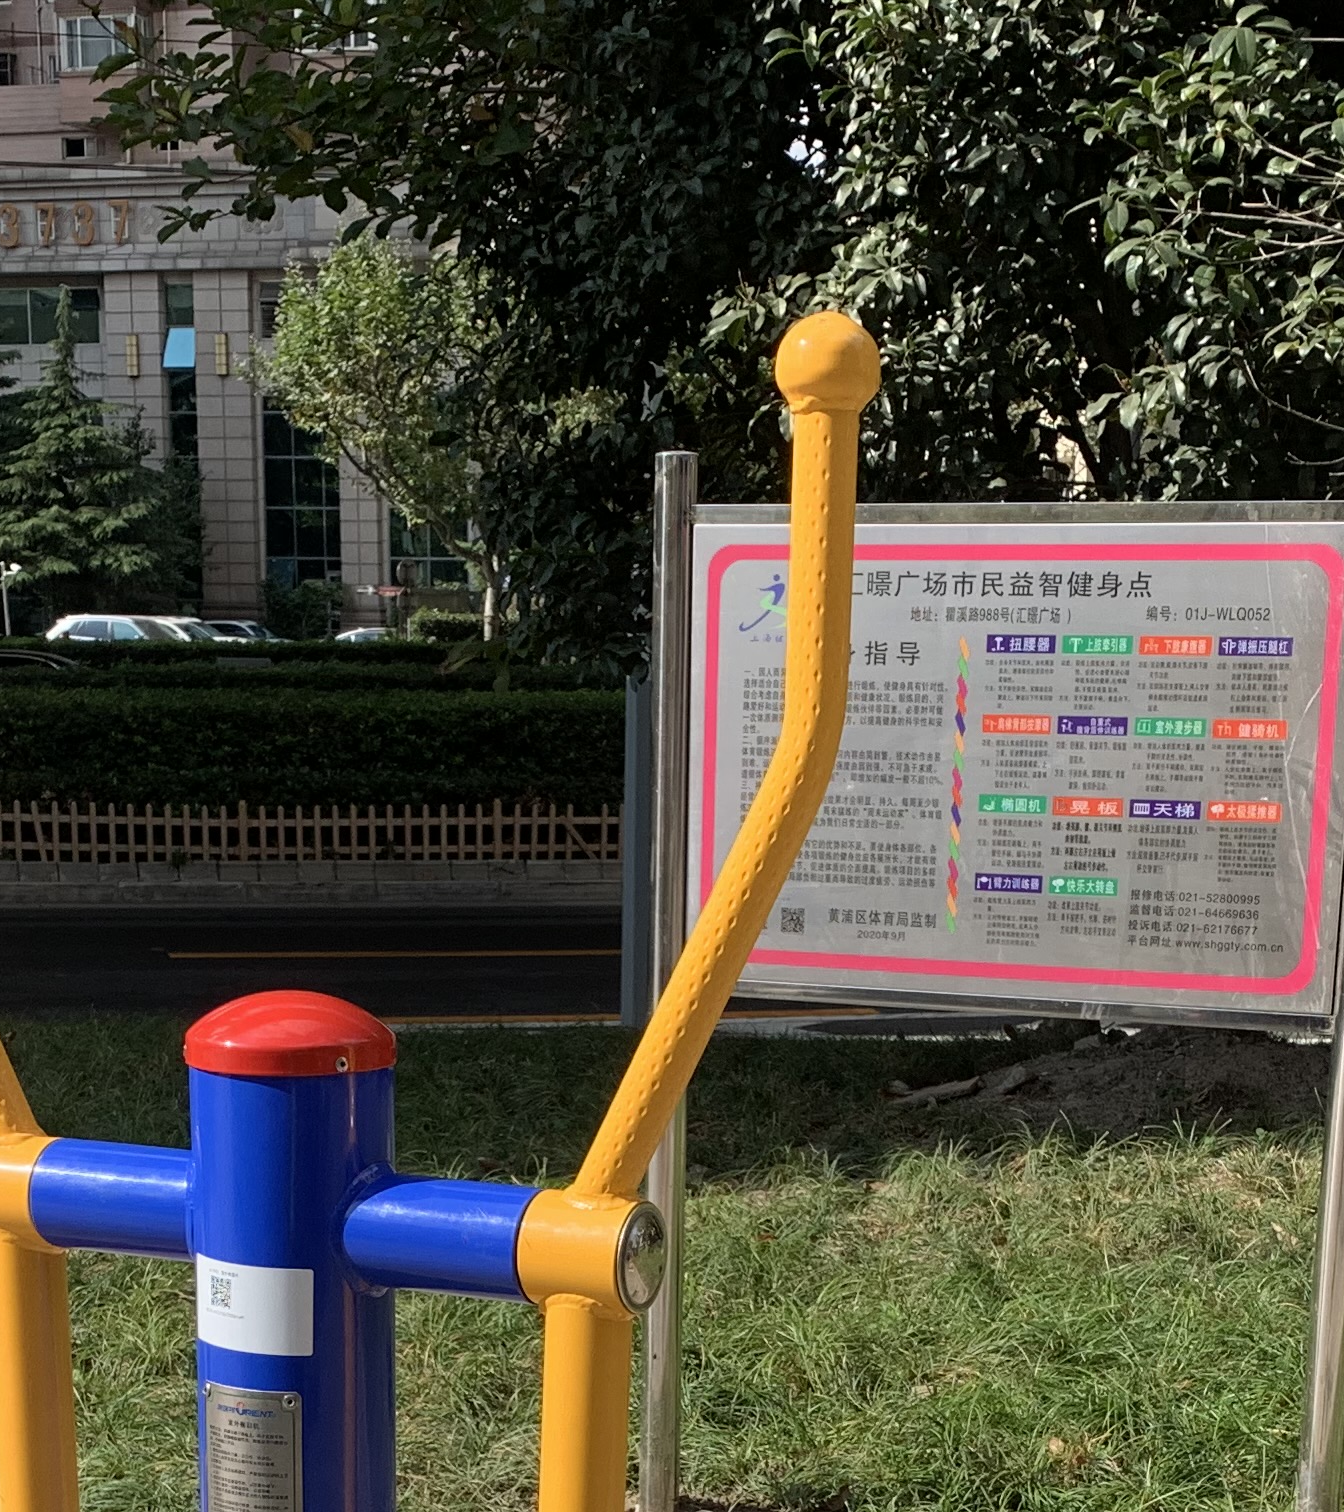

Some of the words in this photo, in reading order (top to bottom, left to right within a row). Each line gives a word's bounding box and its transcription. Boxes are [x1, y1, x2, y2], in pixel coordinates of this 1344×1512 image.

[1009, 636, 1050, 652] 扭腰器
[849, 640, 921, 667] 指导
[1155, 720, 1203, 735] 室外漫步器
[1238, 722, 1279, 738] 健骑机
[1001, 797, 1041, 812] 椭圆机
[1069, 800, 1119, 815] 晃板
[1152, 802, 1195, 818] 天梯
[993, 876, 1040, 891] 臂力训练器
[1066, 878, 1115, 895] 快乐大转盘
[827, 907, 937, 929] 黄浦区体育局监制
[857, 929, 906, 942] 2020年9月
